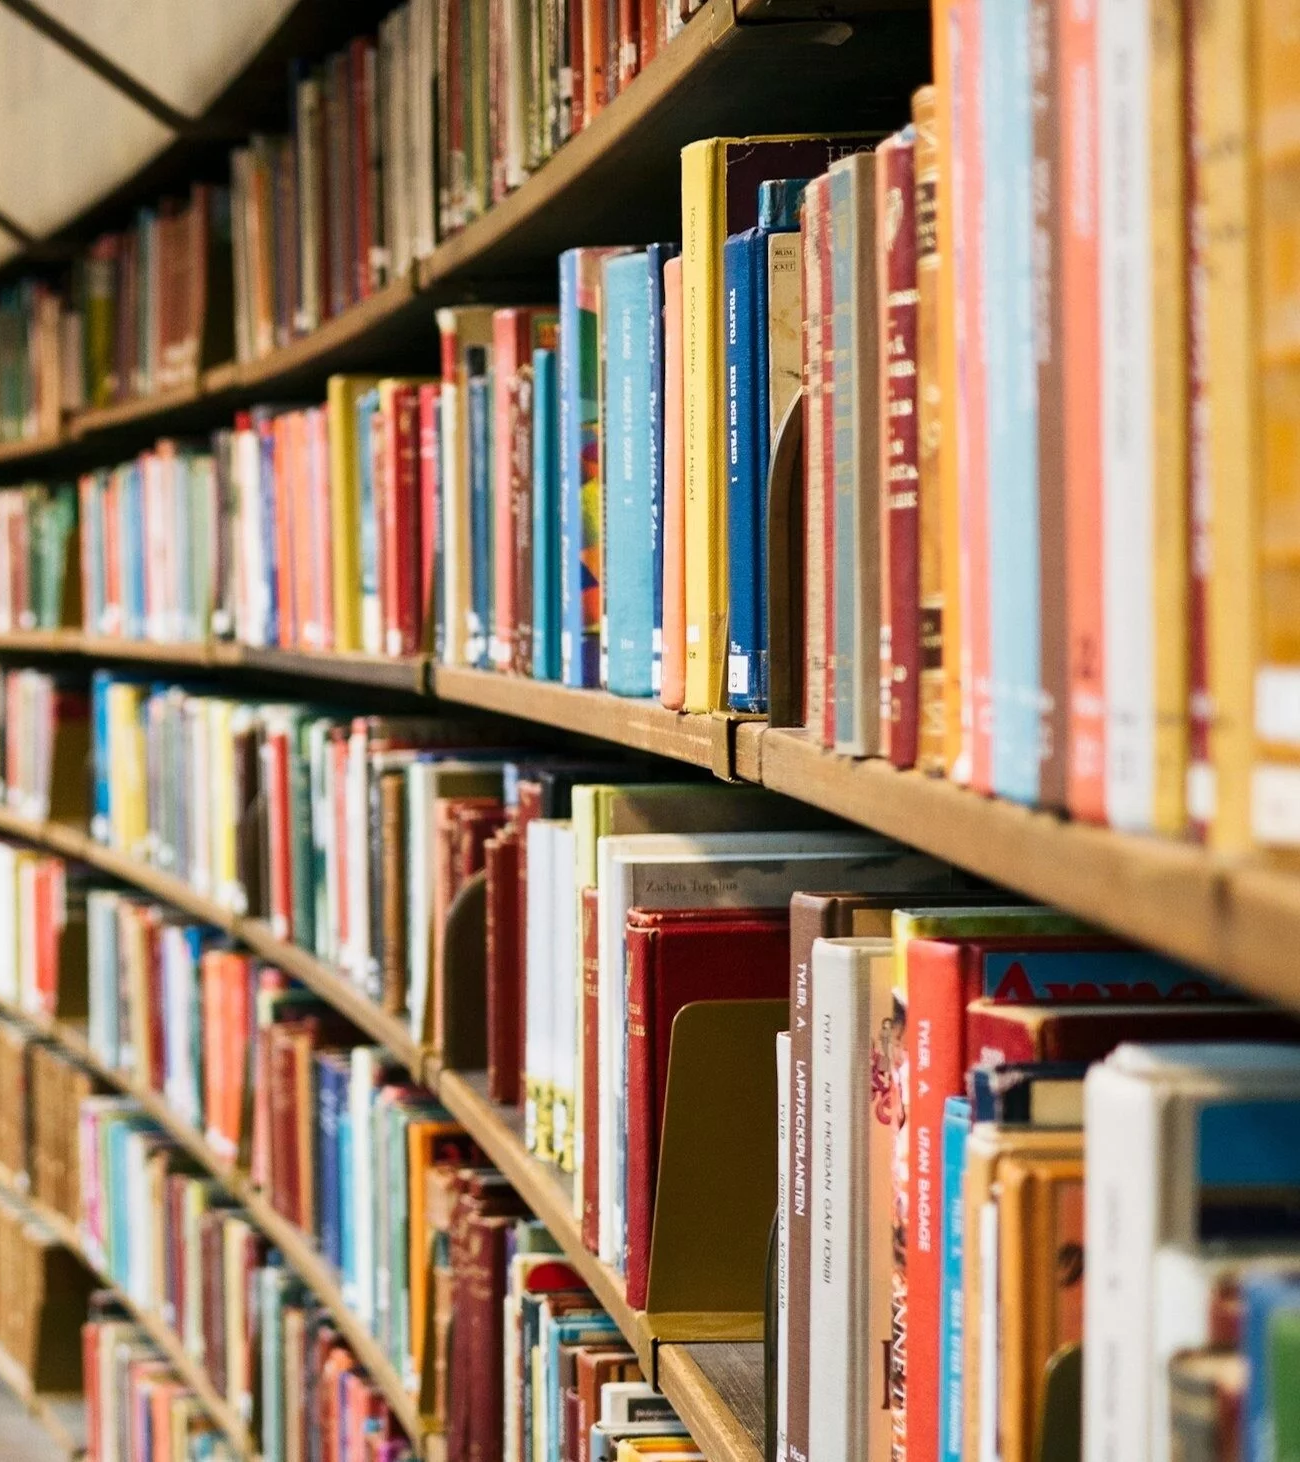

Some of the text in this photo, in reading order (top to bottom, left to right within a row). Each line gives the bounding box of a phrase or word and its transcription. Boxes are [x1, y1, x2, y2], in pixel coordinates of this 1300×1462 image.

[729, 364, 737, 397] KRIG
[691, 879, 738, 895] Topelius
[794, 963, 807, 1216] TYLER, A. LAPPTÄCKSPLANETEN
[917, 1126, 930, 1173] UTAN
[917, 1177, 931, 1253] BAGAGE
[892, 1272, 908, 1376] ANNE
